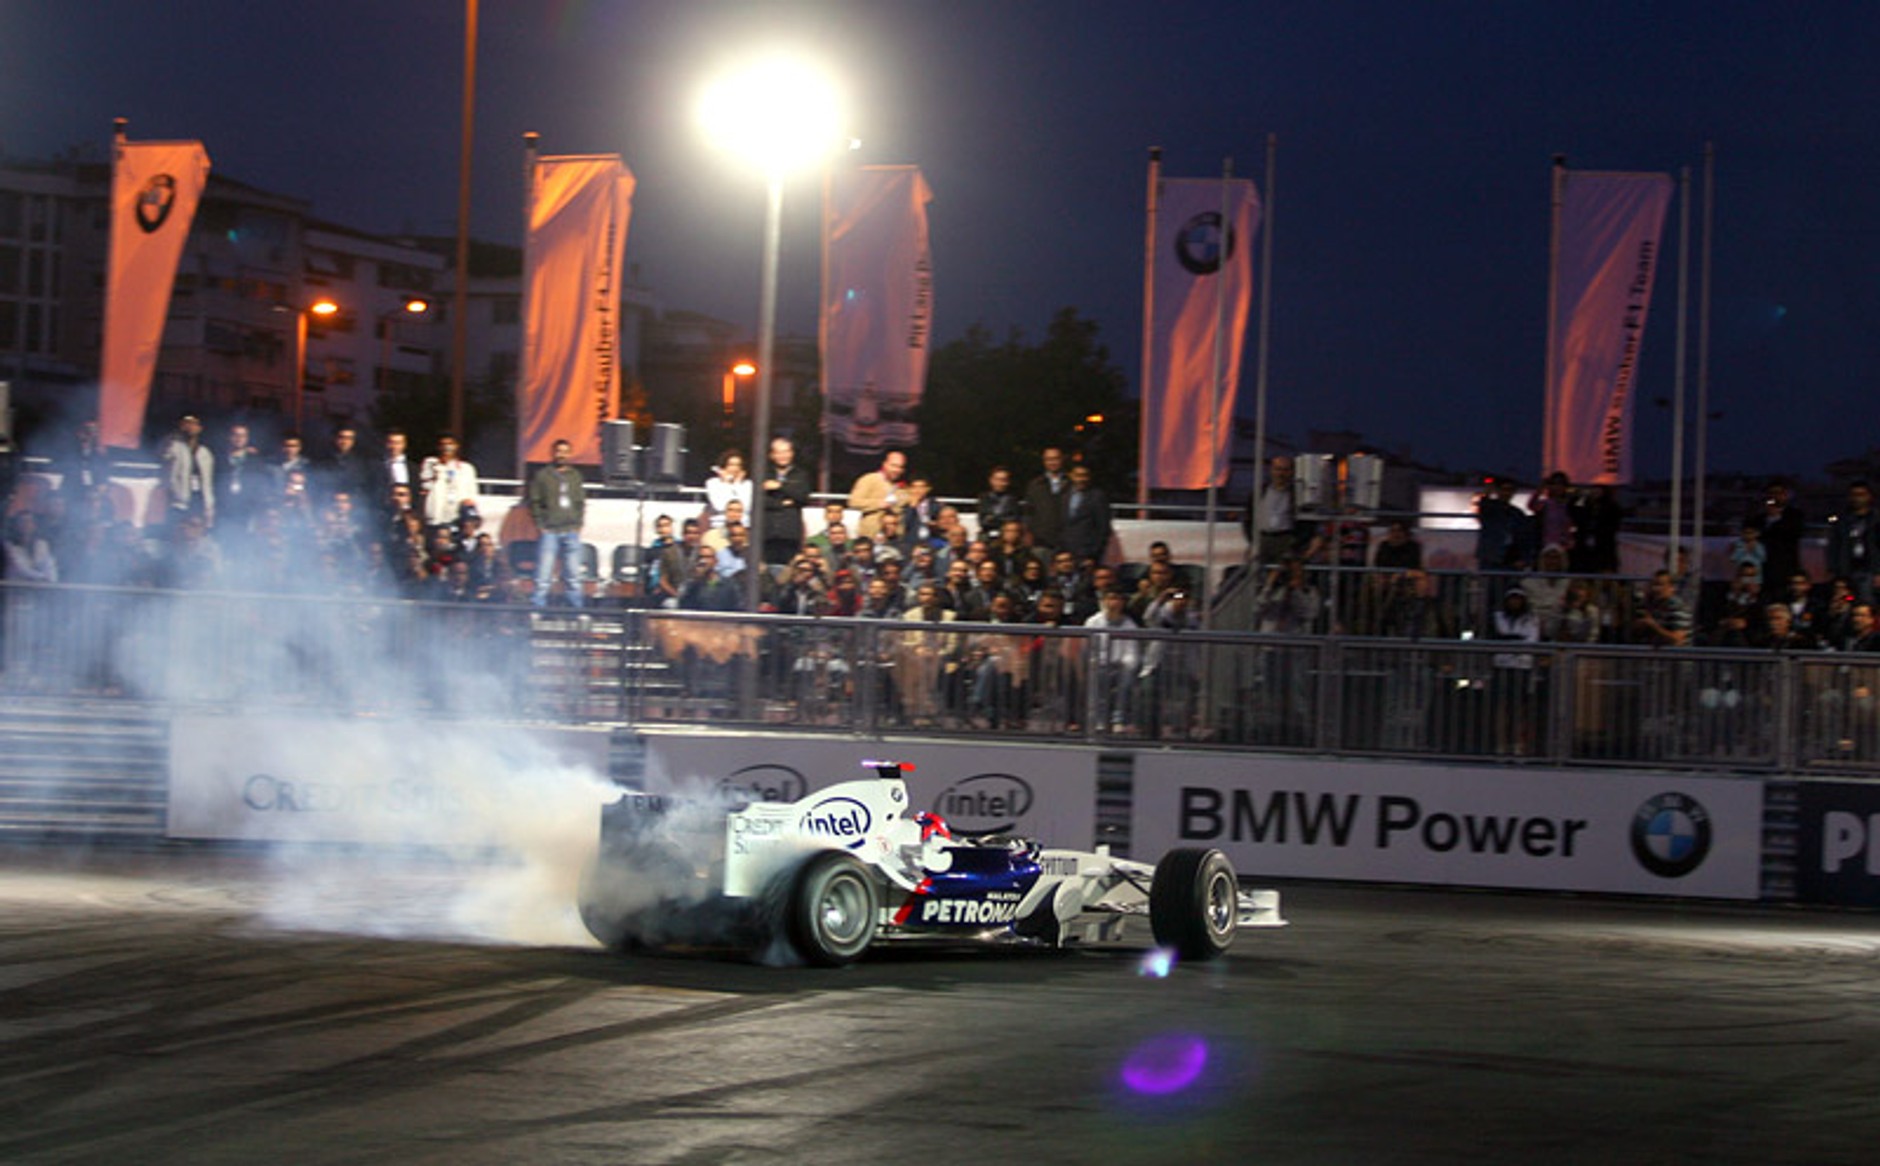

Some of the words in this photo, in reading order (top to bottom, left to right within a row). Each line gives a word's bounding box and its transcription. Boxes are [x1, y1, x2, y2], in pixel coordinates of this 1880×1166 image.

[1627, 239, 1653, 297] Team
[1622, 303, 1643, 330] F1
[1604, 416, 1621, 474] BMW
[948, 784, 1020, 818] intel
[806, 809, 863, 836] intel
[1179, 786, 1360, 847] BMW
[1376, 795, 1588, 858] Power
[921, 899, 1017, 923] PETRONA
